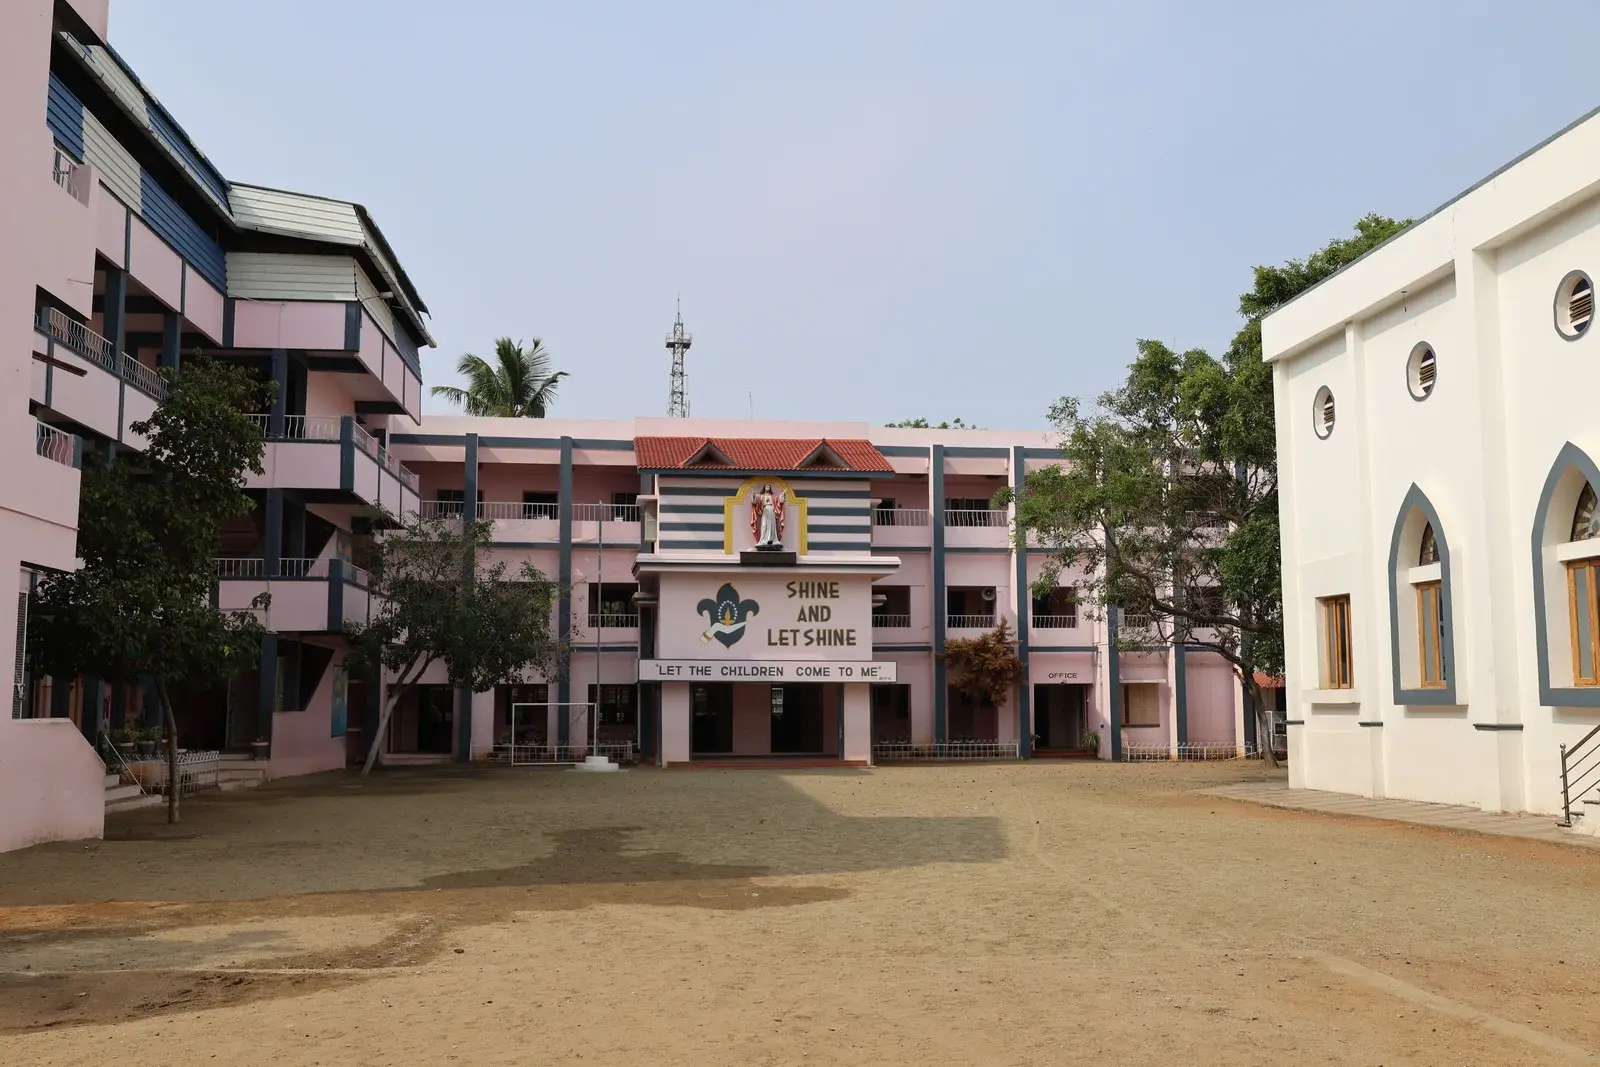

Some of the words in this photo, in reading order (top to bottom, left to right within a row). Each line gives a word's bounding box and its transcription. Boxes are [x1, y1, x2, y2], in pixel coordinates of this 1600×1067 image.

[786, 581, 840, 599] SHINE
[796, 605, 832, 623] AND
[767, 629, 800, 646] LET
[803, 629, 857, 647] SHINE
[689, 666, 712, 676] THE
[720, 666, 784, 677] CHILDREN
[796, 667, 830, 677] COME
[838, 667, 853, 677] TO
